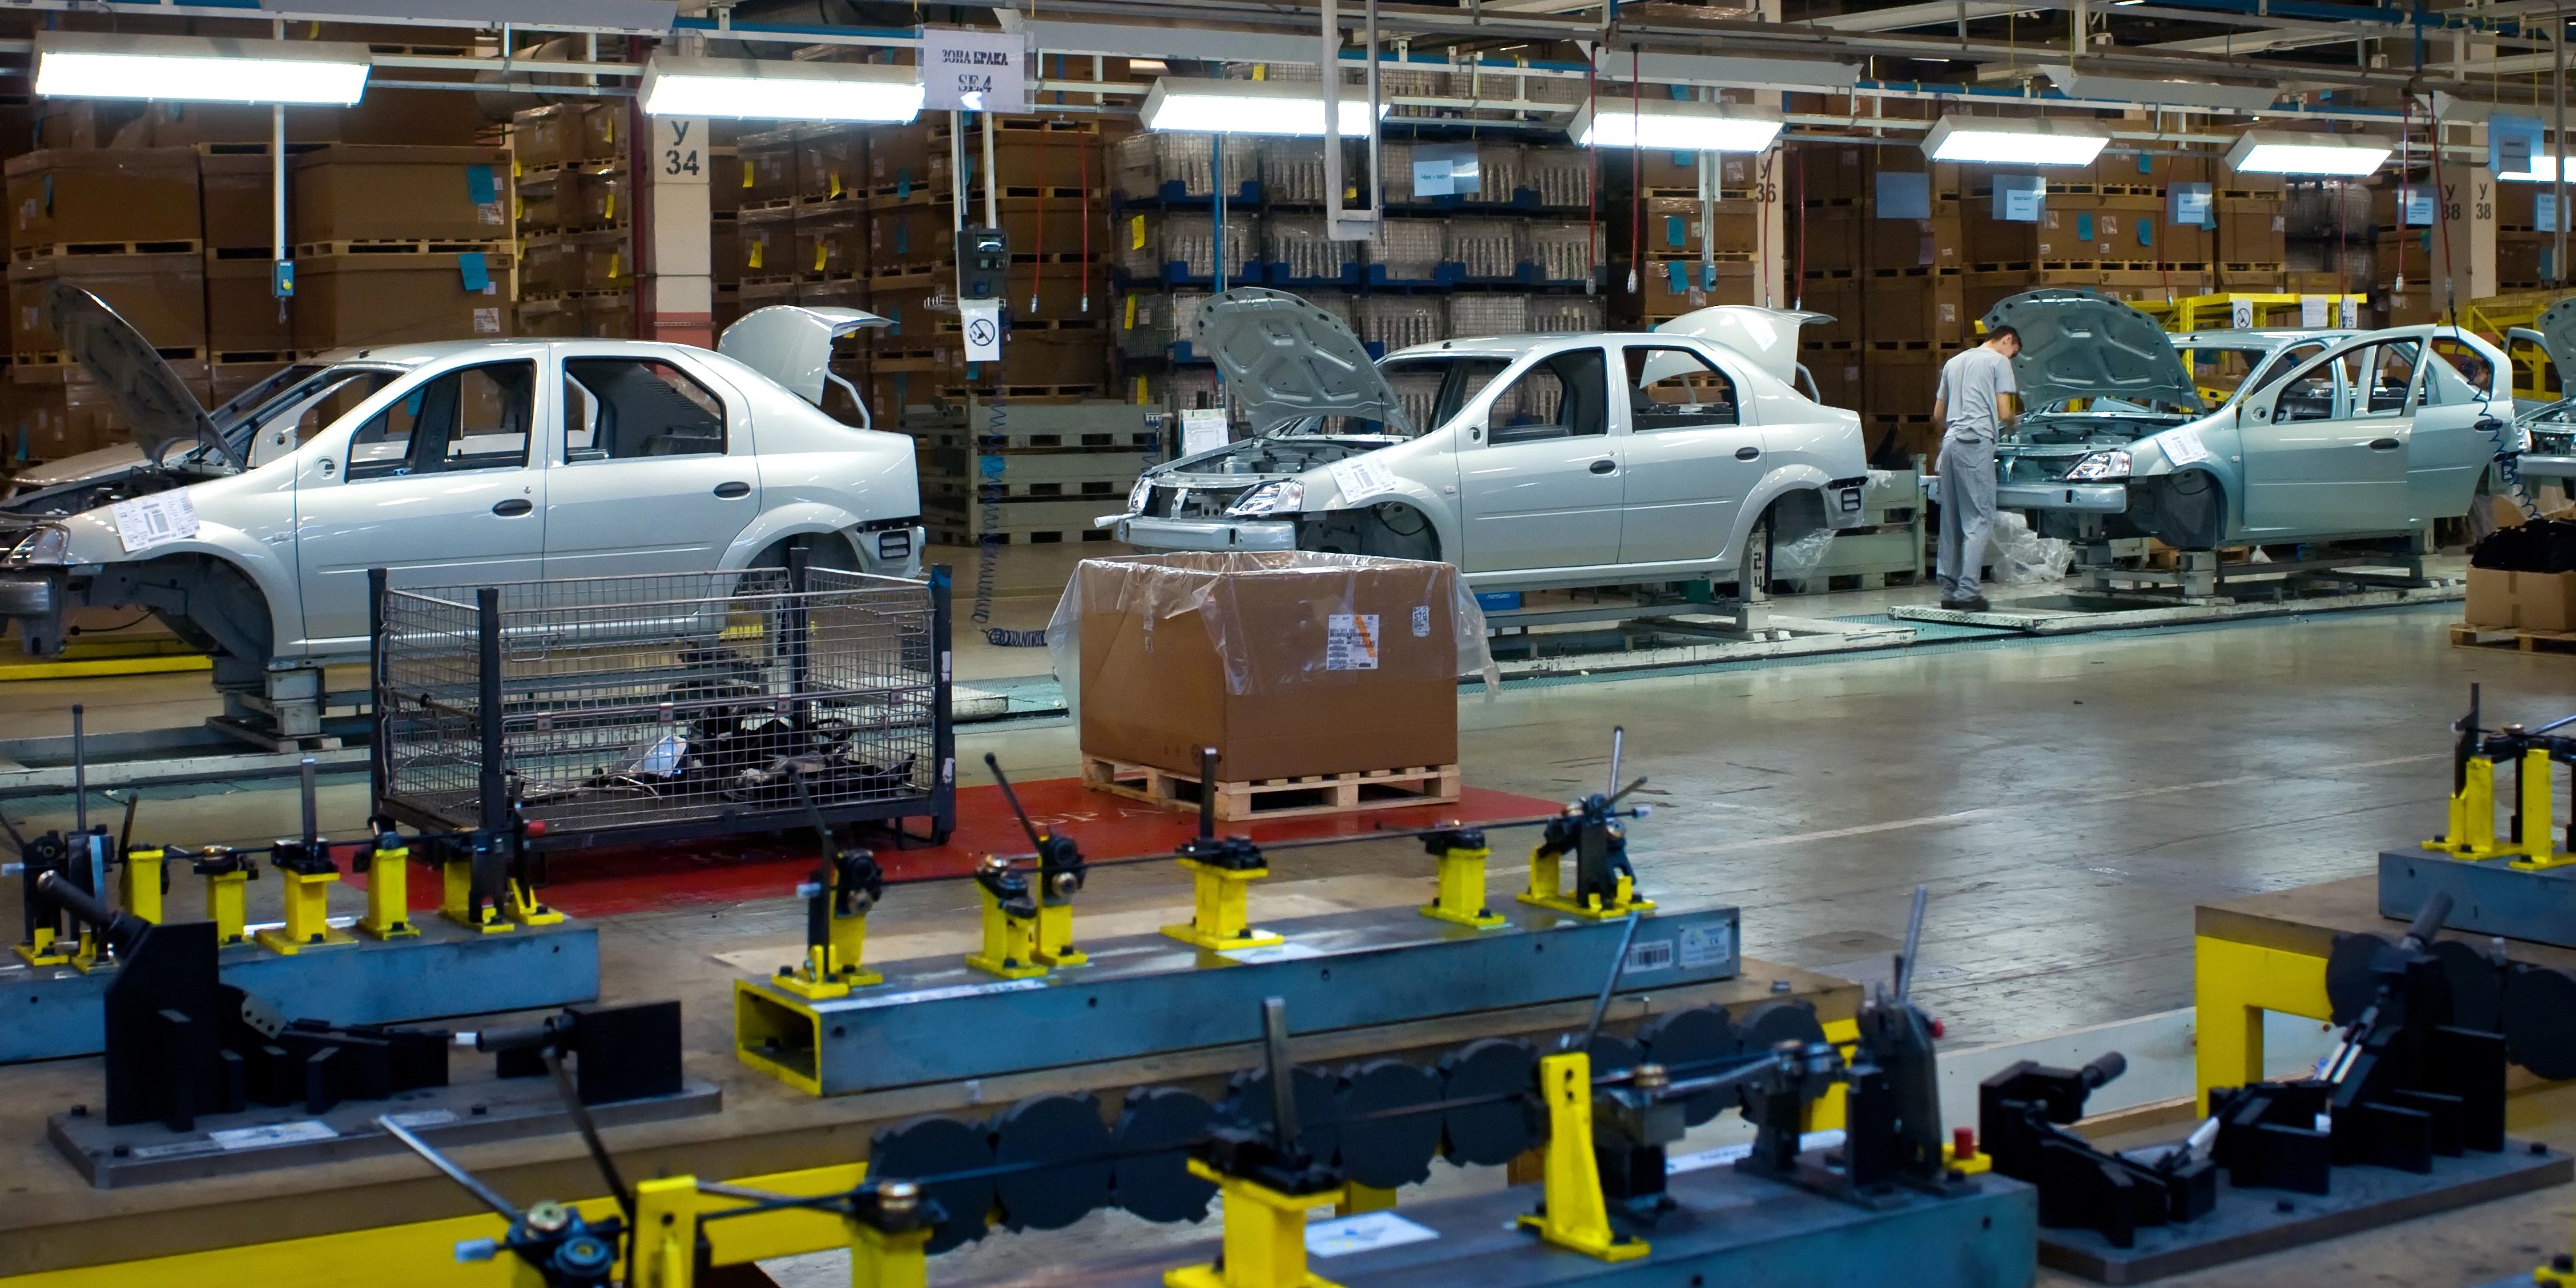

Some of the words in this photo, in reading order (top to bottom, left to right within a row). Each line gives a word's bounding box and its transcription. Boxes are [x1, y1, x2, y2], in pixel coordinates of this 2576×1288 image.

[942, 49, 971, 65] ЗОНА
[973, 51, 1009, 66] БРАКА
[958, 74, 992, 92] SE.4
[665, 149, 700, 176] 34
[1754, 182, 1776, 203] 36
[2444, 203, 2461, 220] 38
[2476, 203, 2492, 220] 38
